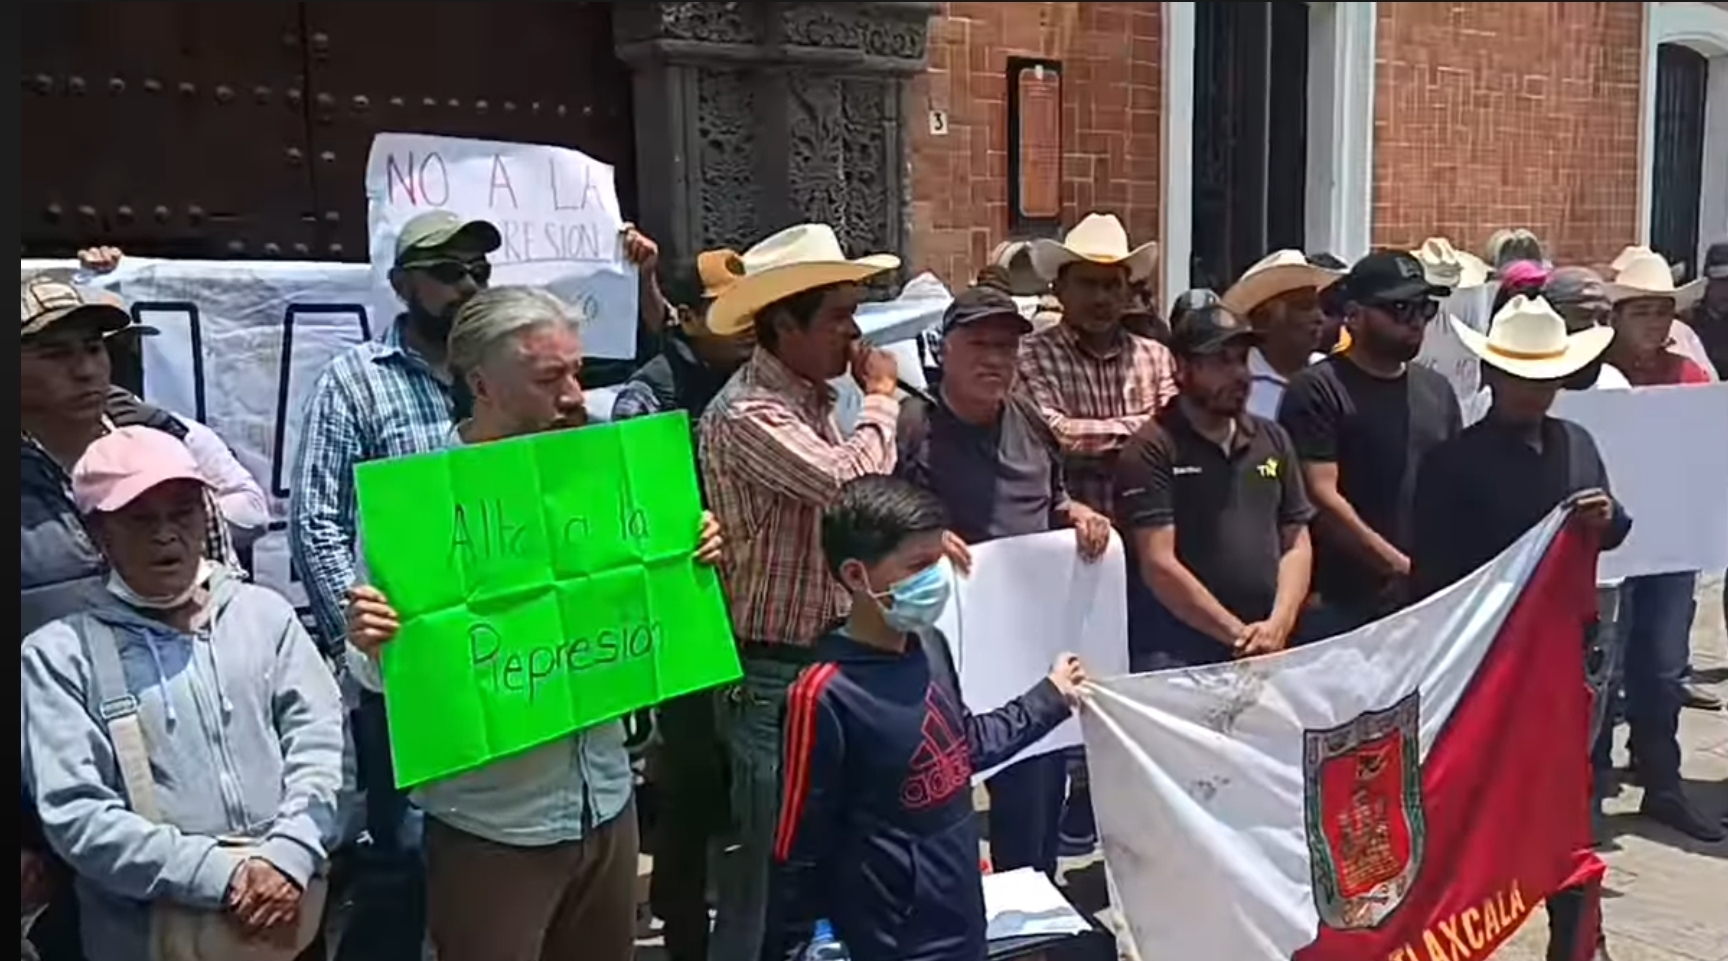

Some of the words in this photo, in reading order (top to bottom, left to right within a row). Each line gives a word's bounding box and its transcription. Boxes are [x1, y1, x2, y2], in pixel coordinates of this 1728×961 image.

[934, 112, 944, 131] 3
[386, 151, 449, 207] NO
[488, 154, 518, 209] A
[549, 156, 606, 211] LA
[497, 220, 600, 261] RESION
[618, 480, 649, 540] la
